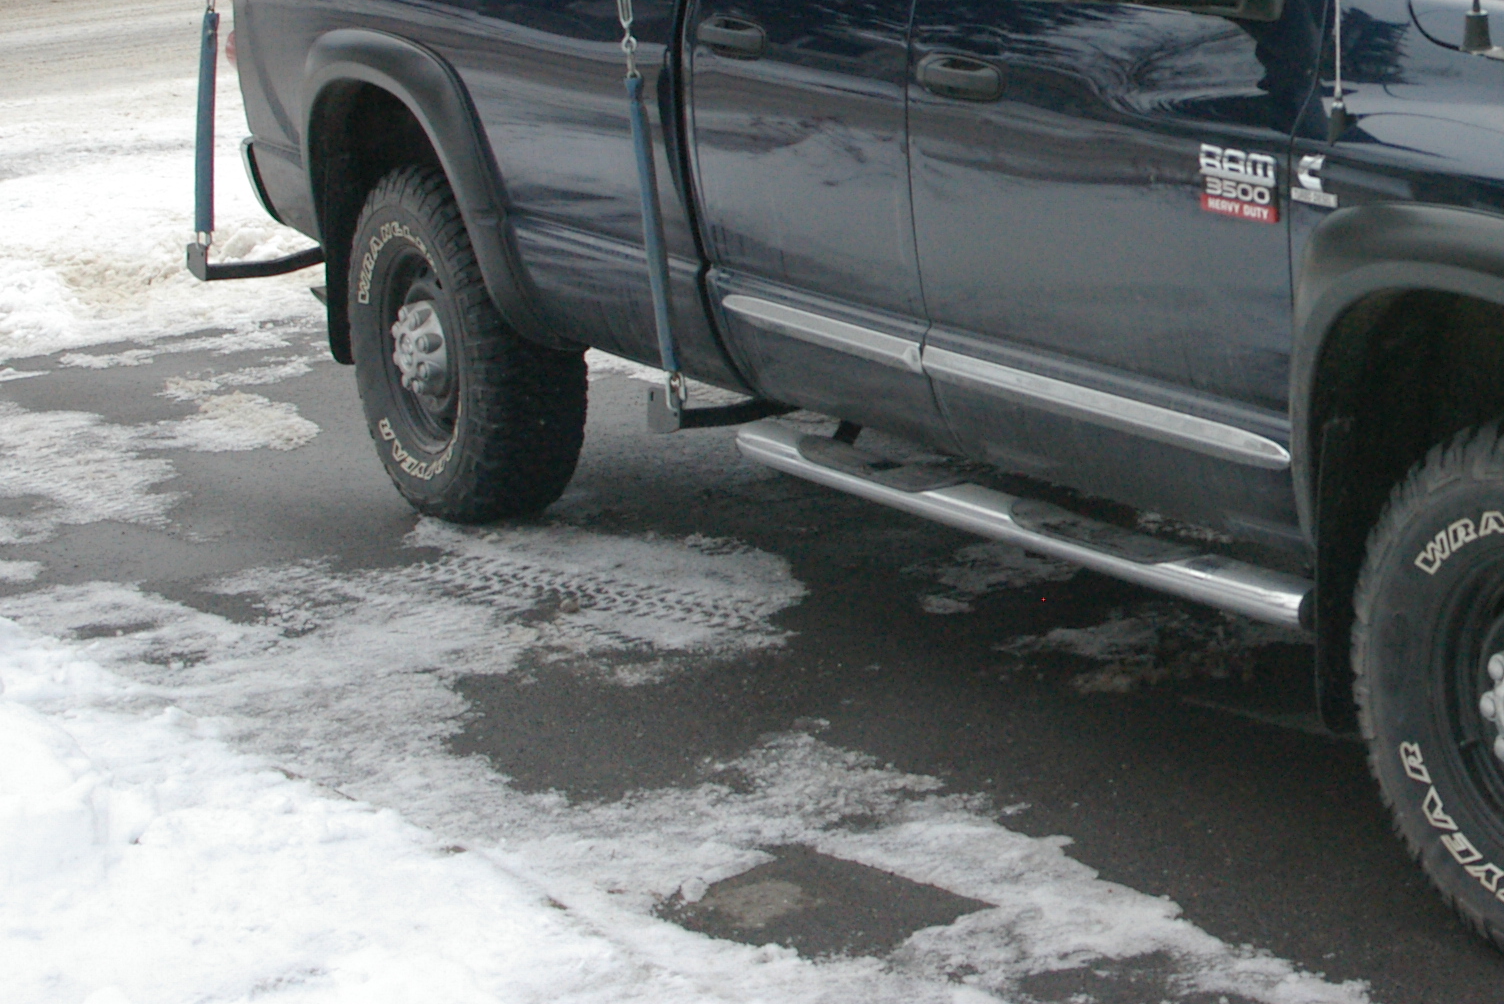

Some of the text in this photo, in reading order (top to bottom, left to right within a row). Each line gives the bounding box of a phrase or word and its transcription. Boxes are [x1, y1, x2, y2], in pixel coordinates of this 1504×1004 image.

[1205, 177, 1271, 205] 3500
[1207, 197, 1269, 221] HEAVY DUTY
